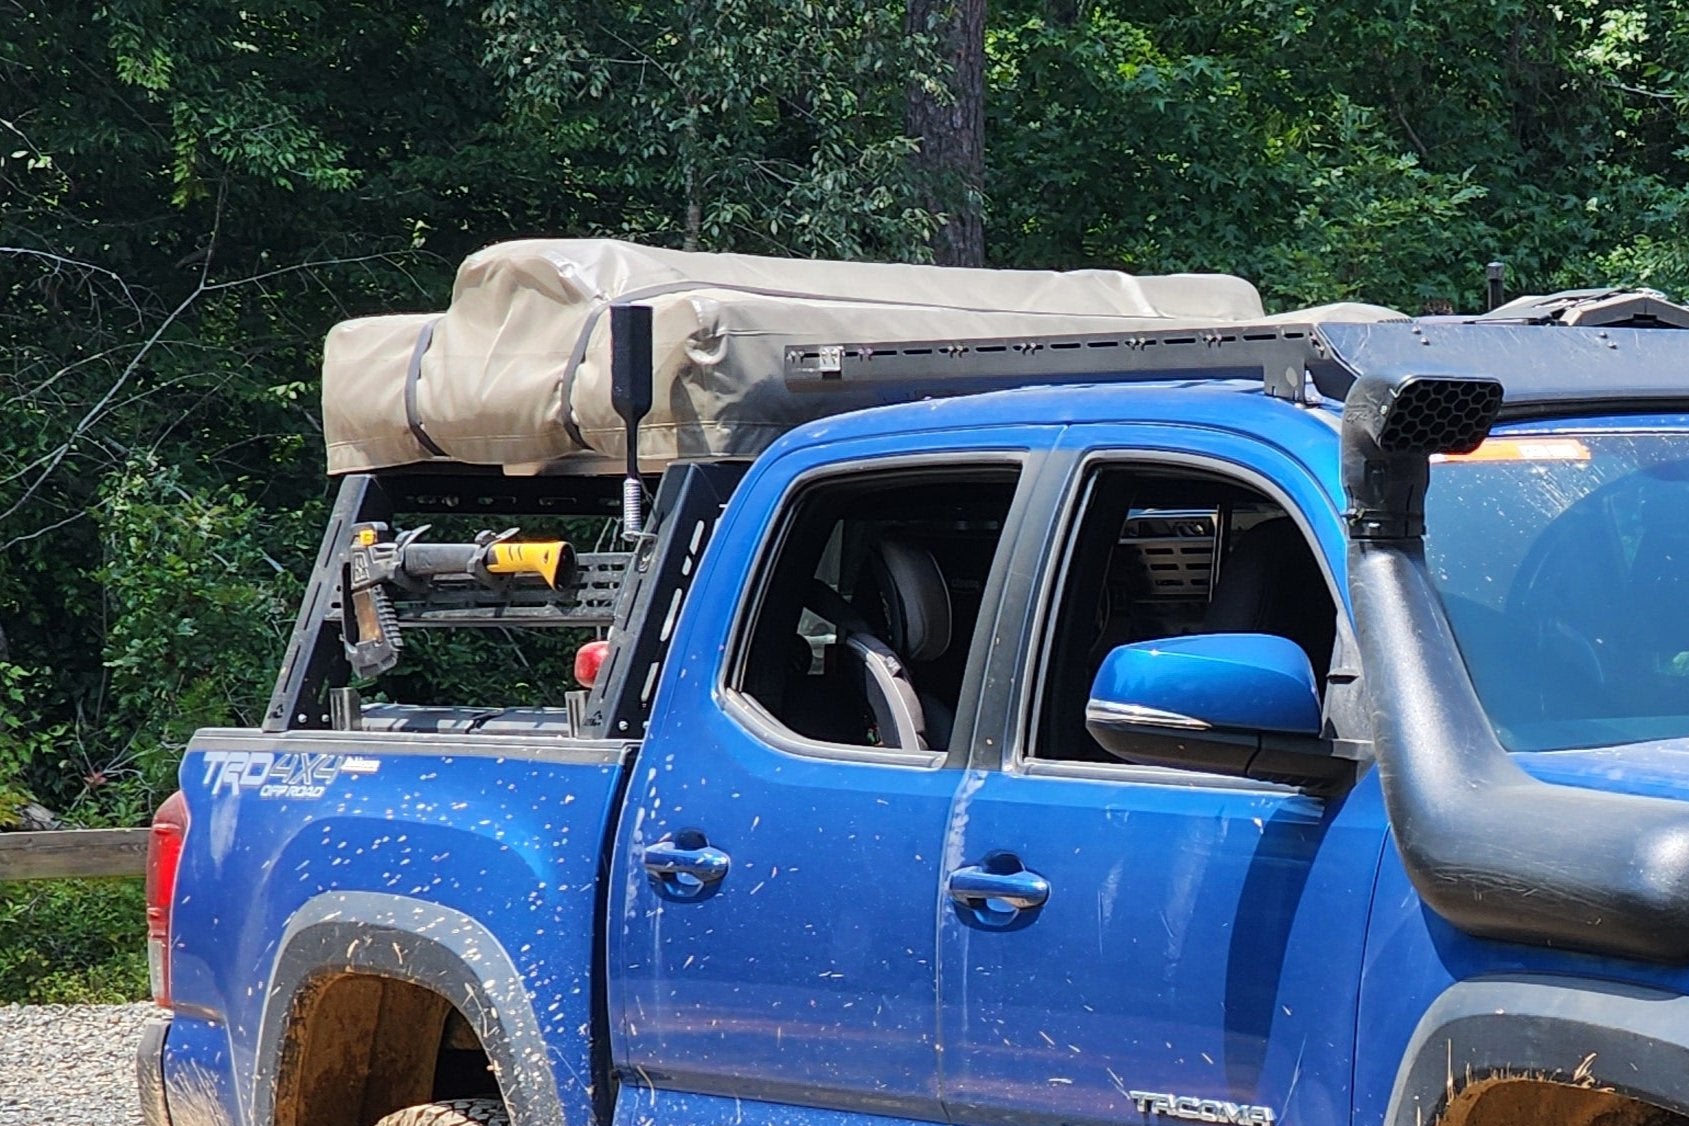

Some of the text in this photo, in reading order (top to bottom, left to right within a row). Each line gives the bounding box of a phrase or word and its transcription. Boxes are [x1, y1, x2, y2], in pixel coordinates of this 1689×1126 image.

[202, 751, 274, 796] TRD
[260, 785, 325, 798] OFF ROAD
